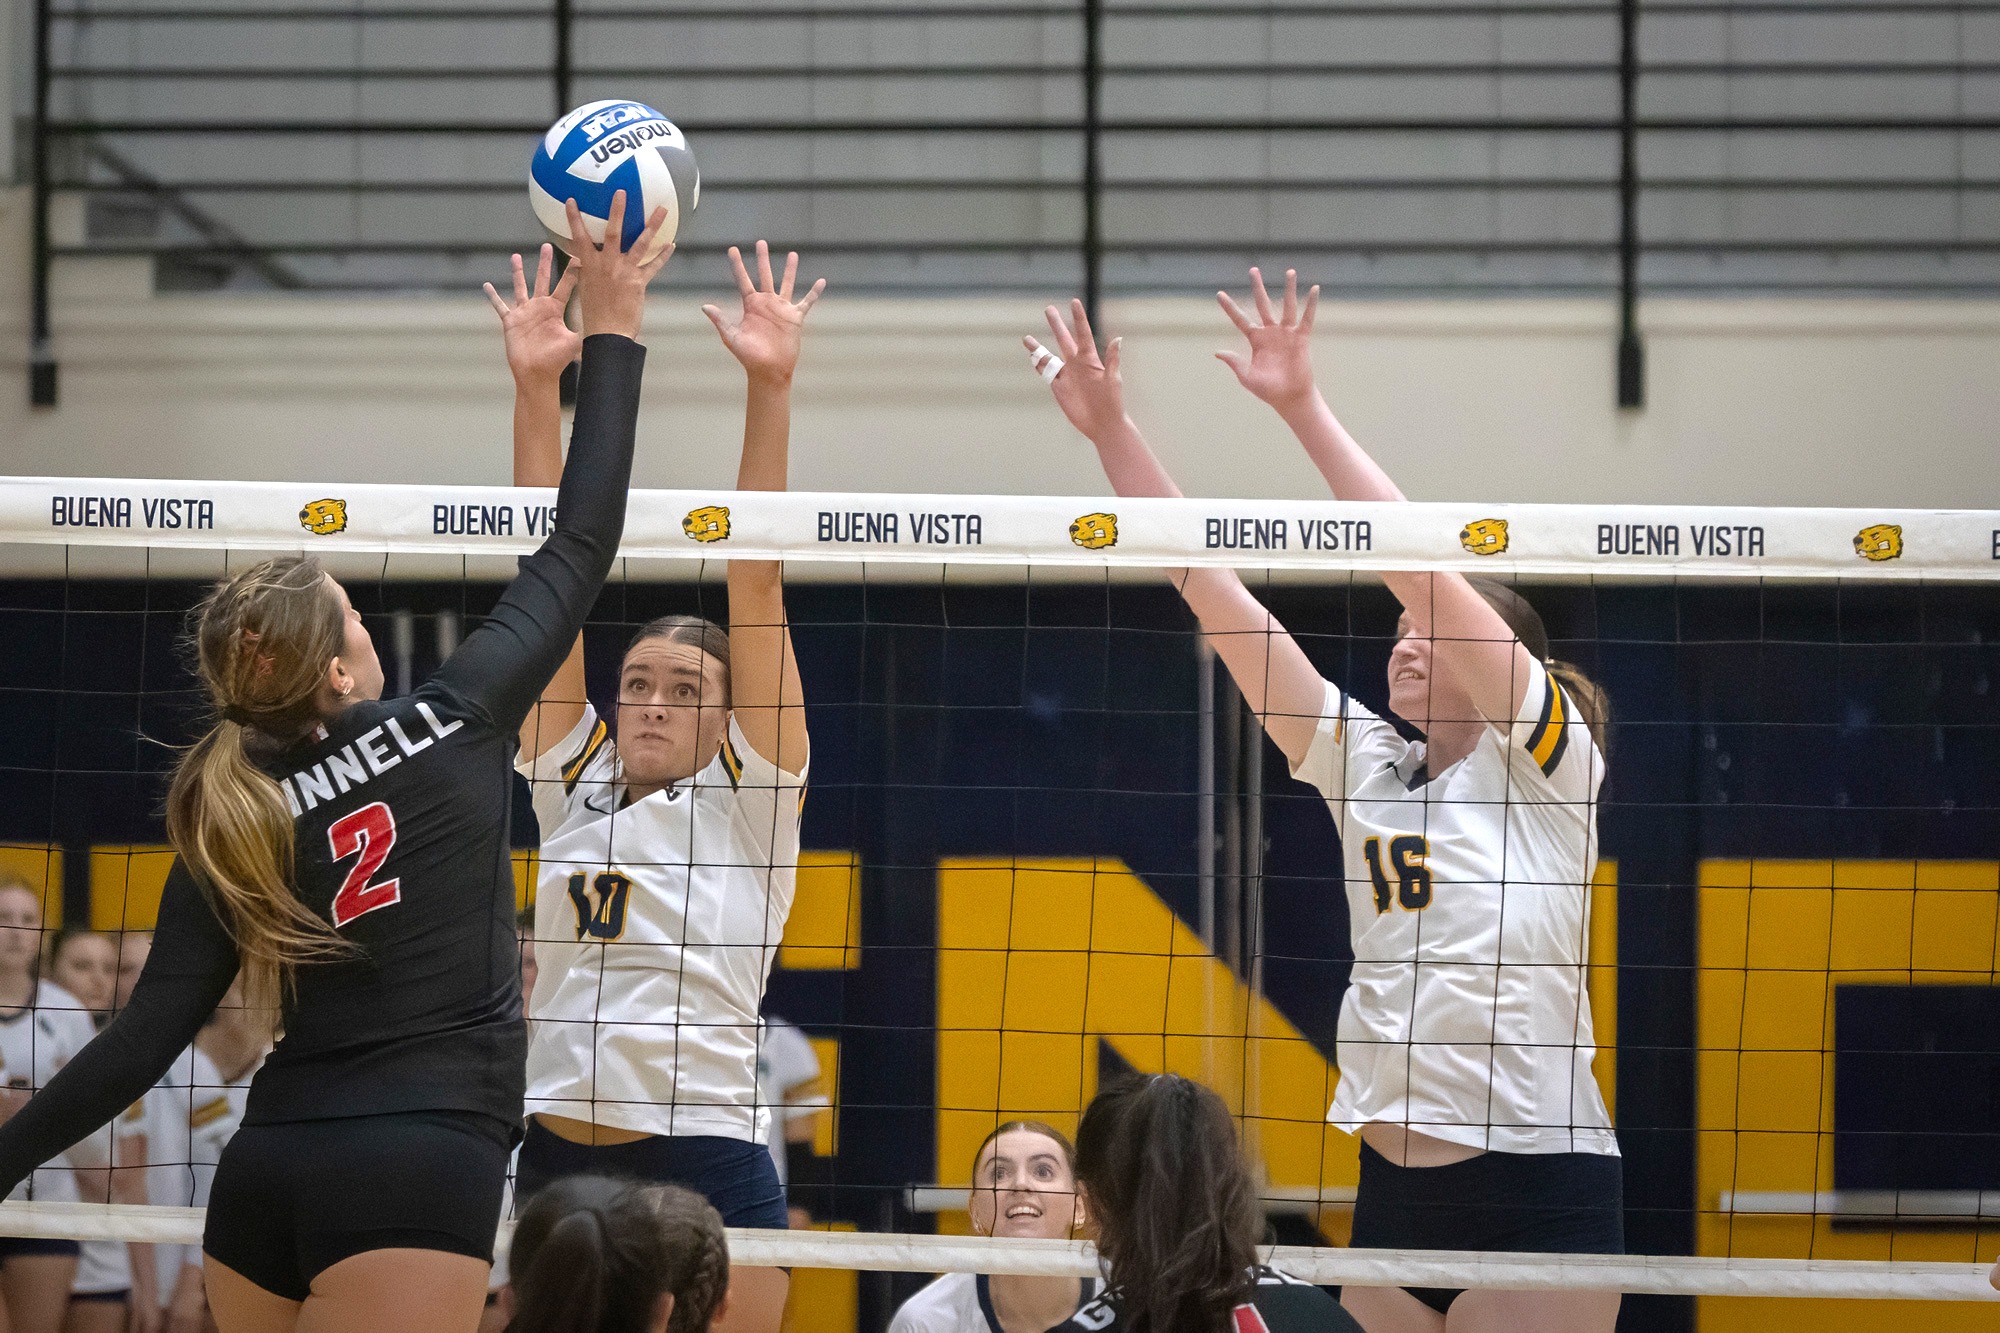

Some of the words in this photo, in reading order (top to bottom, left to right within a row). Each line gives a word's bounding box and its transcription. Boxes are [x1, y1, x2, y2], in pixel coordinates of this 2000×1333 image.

[580, 105, 652, 142] NCAA
[590, 122, 672, 164] molten
[52, 496, 132, 528] BUENA
[141, 498, 214, 530] VISTA
[433, 504, 513, 536] BUENA
[523, 506, 558, 537] VIS
[818, 511, 898, 544] BUENA
[909, 513, 982, 545] VISTA
[1206, 518, 1287, 550] BUENA
[1298, 519, 1371, 551] VISTA
[1597, 524, 1679, 556] BUENA
[1690, 525, 1764, 557] VISTA
[279, 701, 465, 818] INNELL
[327, 801, 401, 929] 2
[1363, 834, 1433, 917] 16
[567, 870, 633, 942] 10
